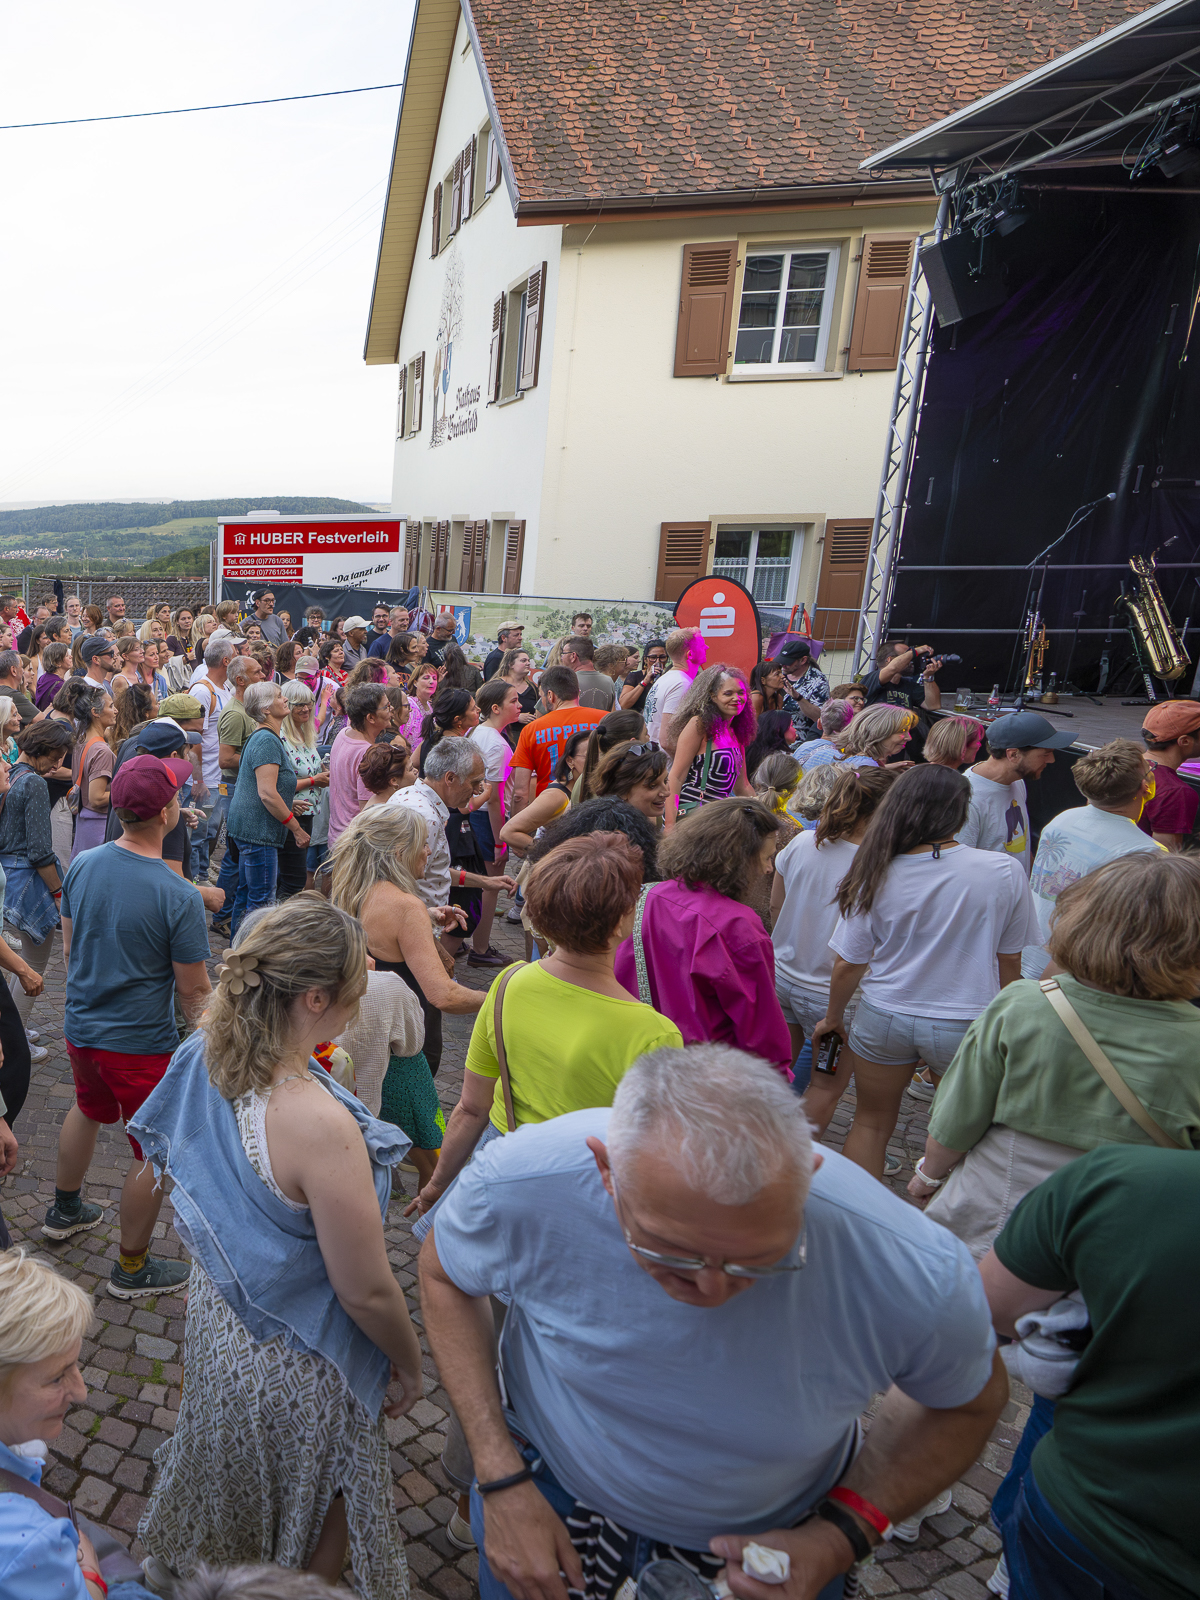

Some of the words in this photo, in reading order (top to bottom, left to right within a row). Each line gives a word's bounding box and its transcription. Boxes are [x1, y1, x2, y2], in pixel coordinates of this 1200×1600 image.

[250, 532, 304, 544] HUBER
[308, 531, 388, 544] Festverleih
[351, 567, 373, 580] tanzt
[374, 564, 390, 573] der
